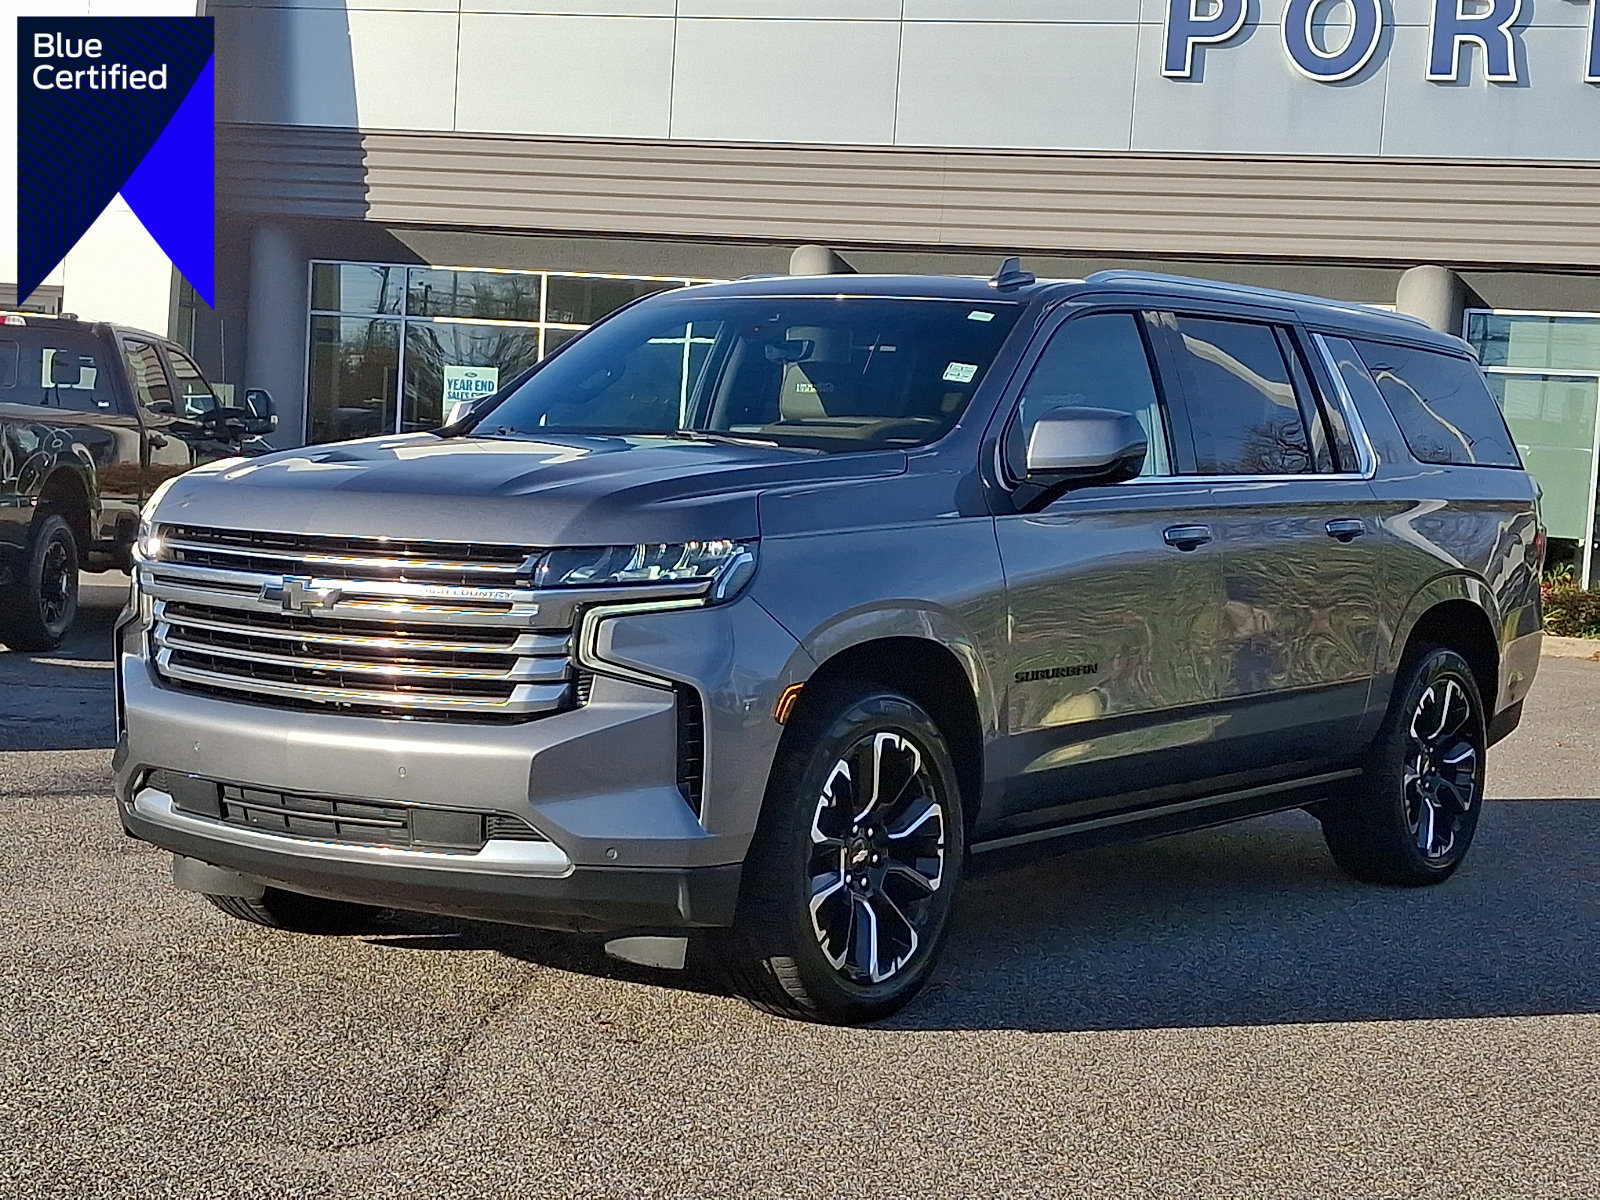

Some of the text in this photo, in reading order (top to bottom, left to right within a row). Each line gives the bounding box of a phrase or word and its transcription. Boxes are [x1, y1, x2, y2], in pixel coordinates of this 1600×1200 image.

[1161, 0, 1600, 82] POR
[447, 378, 494, 392] YEAR END
[453, 590, 514, 599] COUNTRY
[1014, 663, 1098, 683] SUBURBAN
